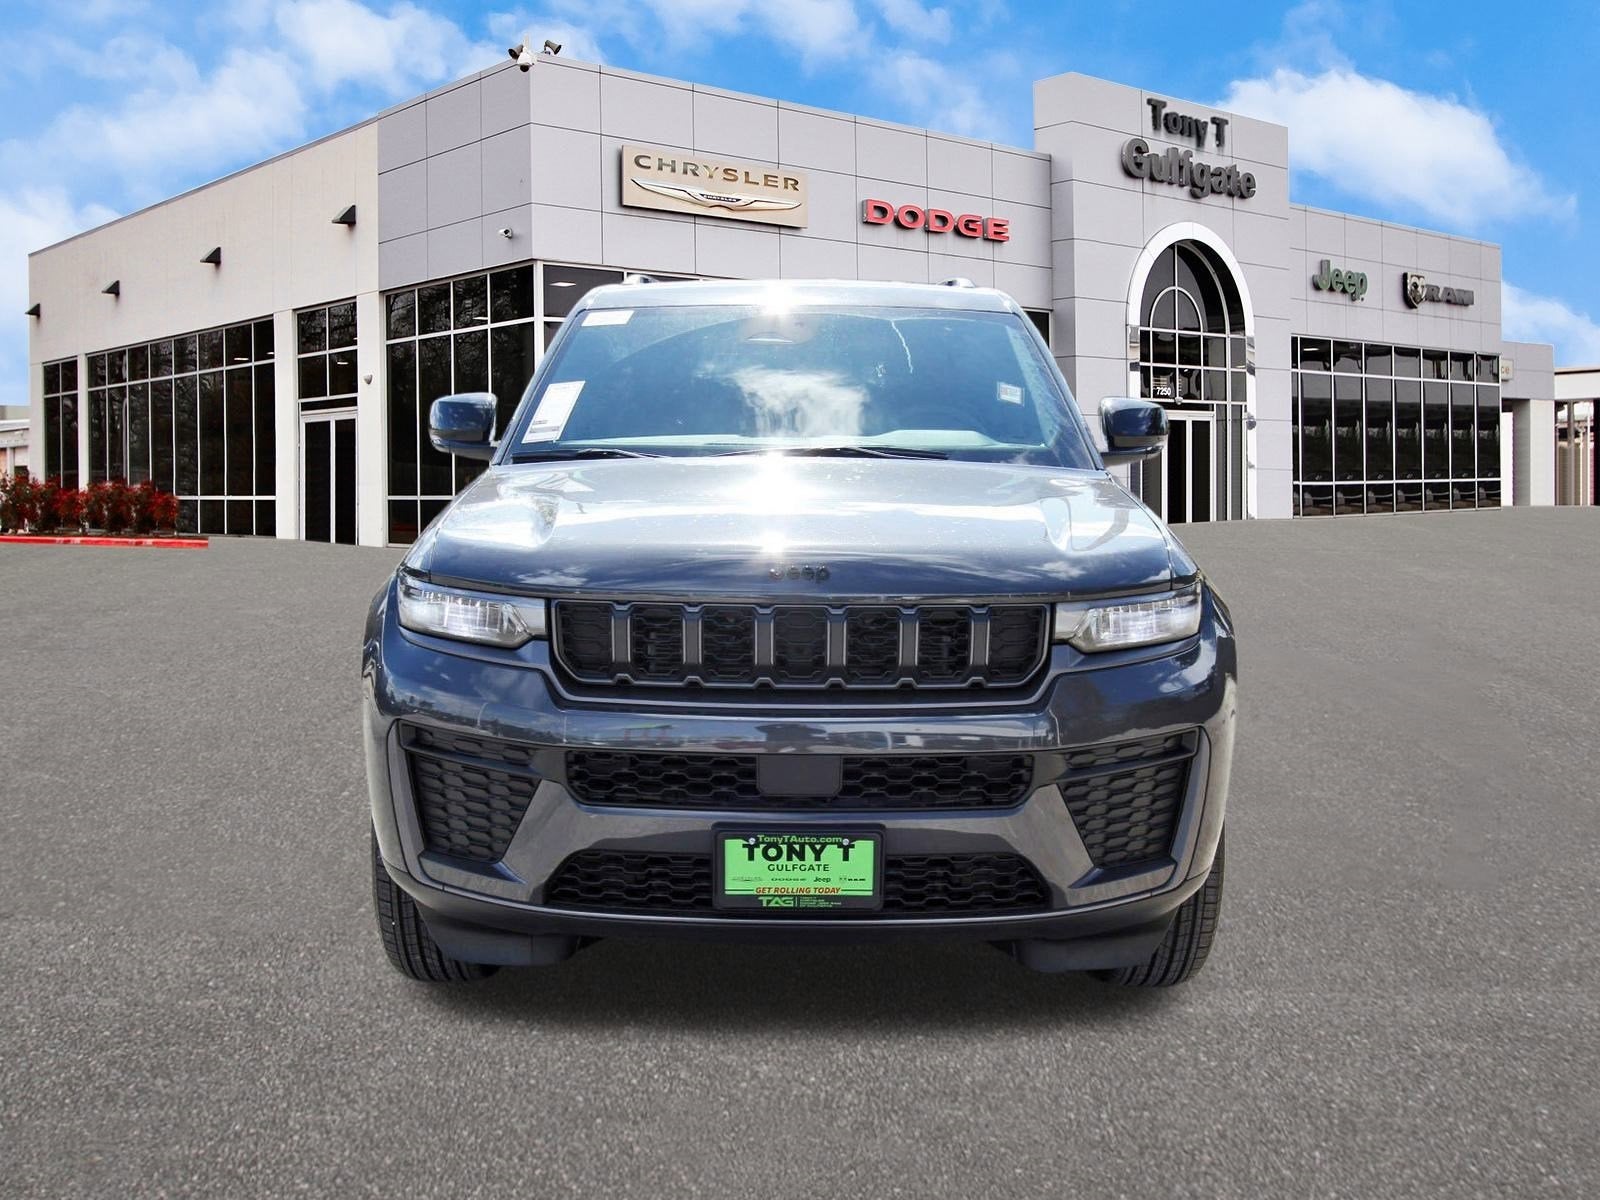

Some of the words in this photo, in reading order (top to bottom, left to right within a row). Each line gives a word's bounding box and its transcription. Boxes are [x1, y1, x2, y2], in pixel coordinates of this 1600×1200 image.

[1147, 98, 1209, 148] Tony
[1210, 116, 1229, 147] T
[633, 153, 801, 193] CHRYSLER
[1121, 138, 1257, 199] Gulfgate
[863, 198, 1011, 243] DODGE
[1312, 258, 1369, 303] Jeep
[1425, 284, 1475, 307] RAM
[742, 843, 828, 862] TONY
[837, 843, 855, 862] T
[757, 834, 843, 845] TonyTAuto.com
[767, 863, 830, 872] GULFGATE
